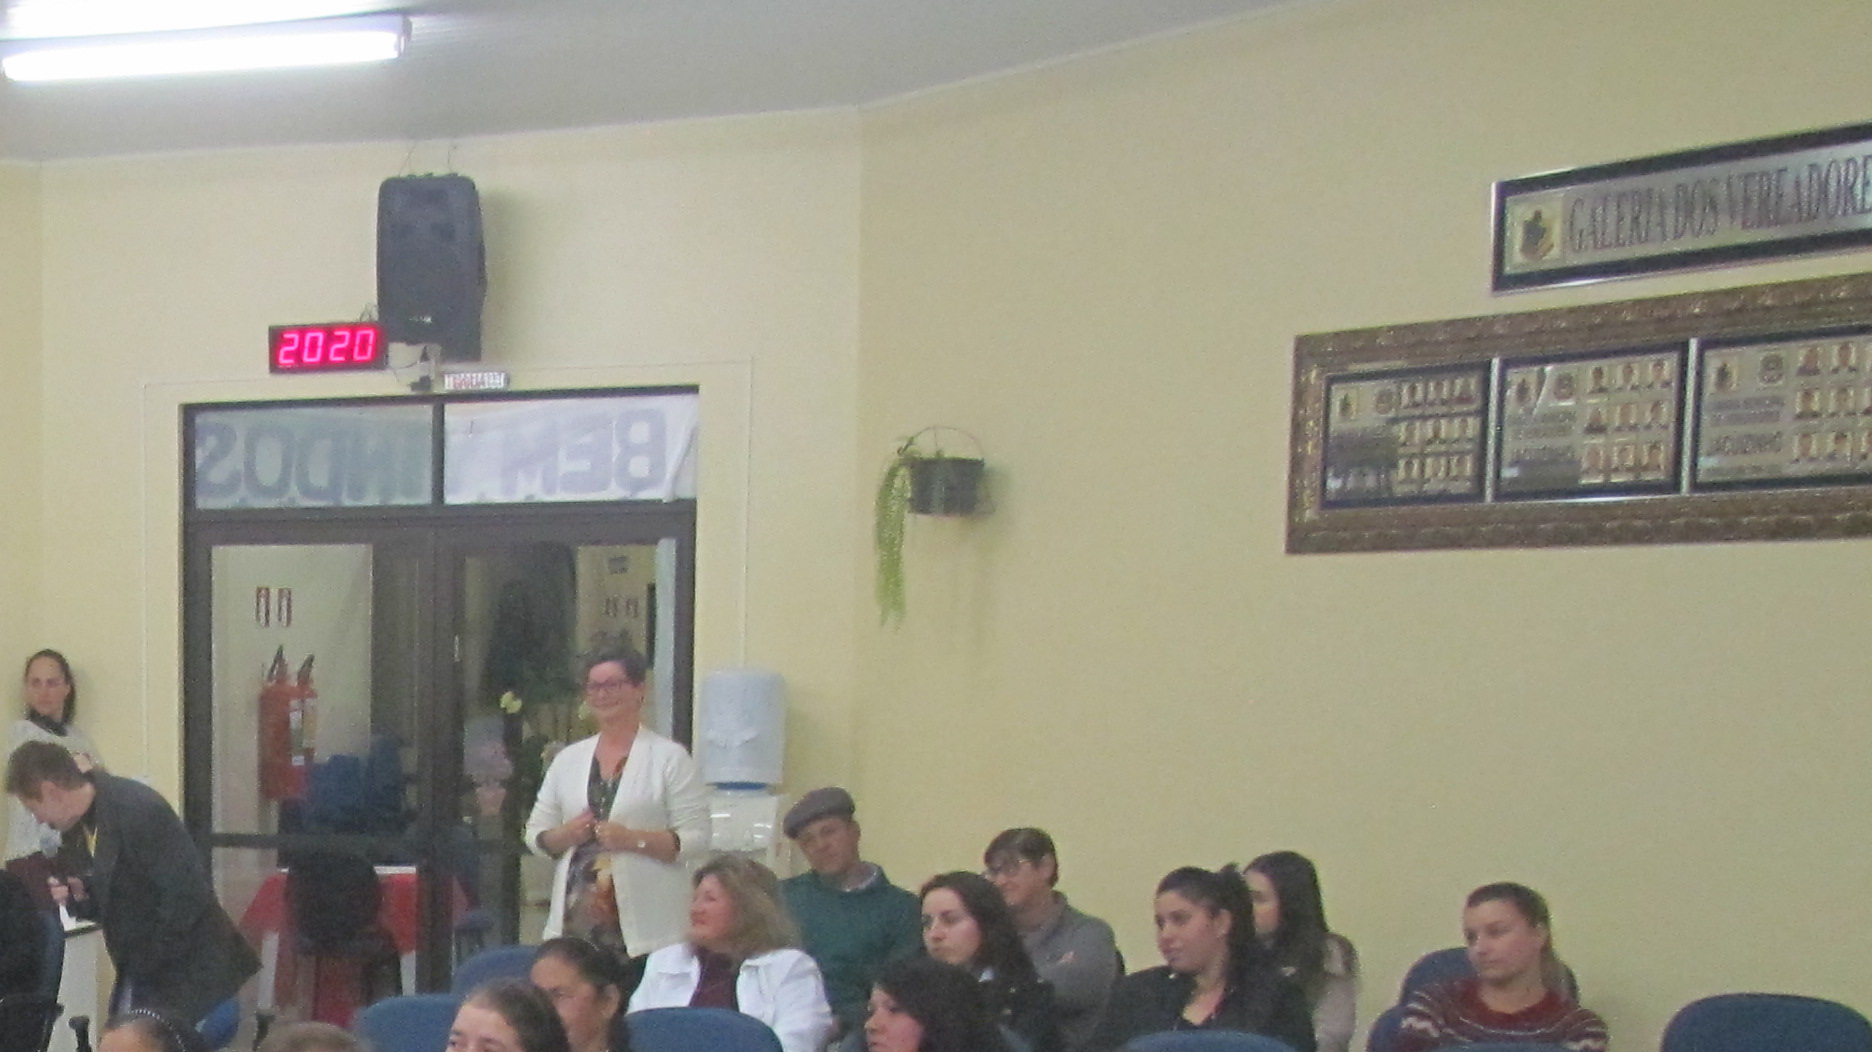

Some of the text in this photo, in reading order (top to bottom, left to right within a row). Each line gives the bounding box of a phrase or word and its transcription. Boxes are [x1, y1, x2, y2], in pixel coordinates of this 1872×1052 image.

[1568, 187, 1668, 250] GALERIA
[1674, 175, 1719, 240] DOS
[278, 328, 377, 367] 2020
